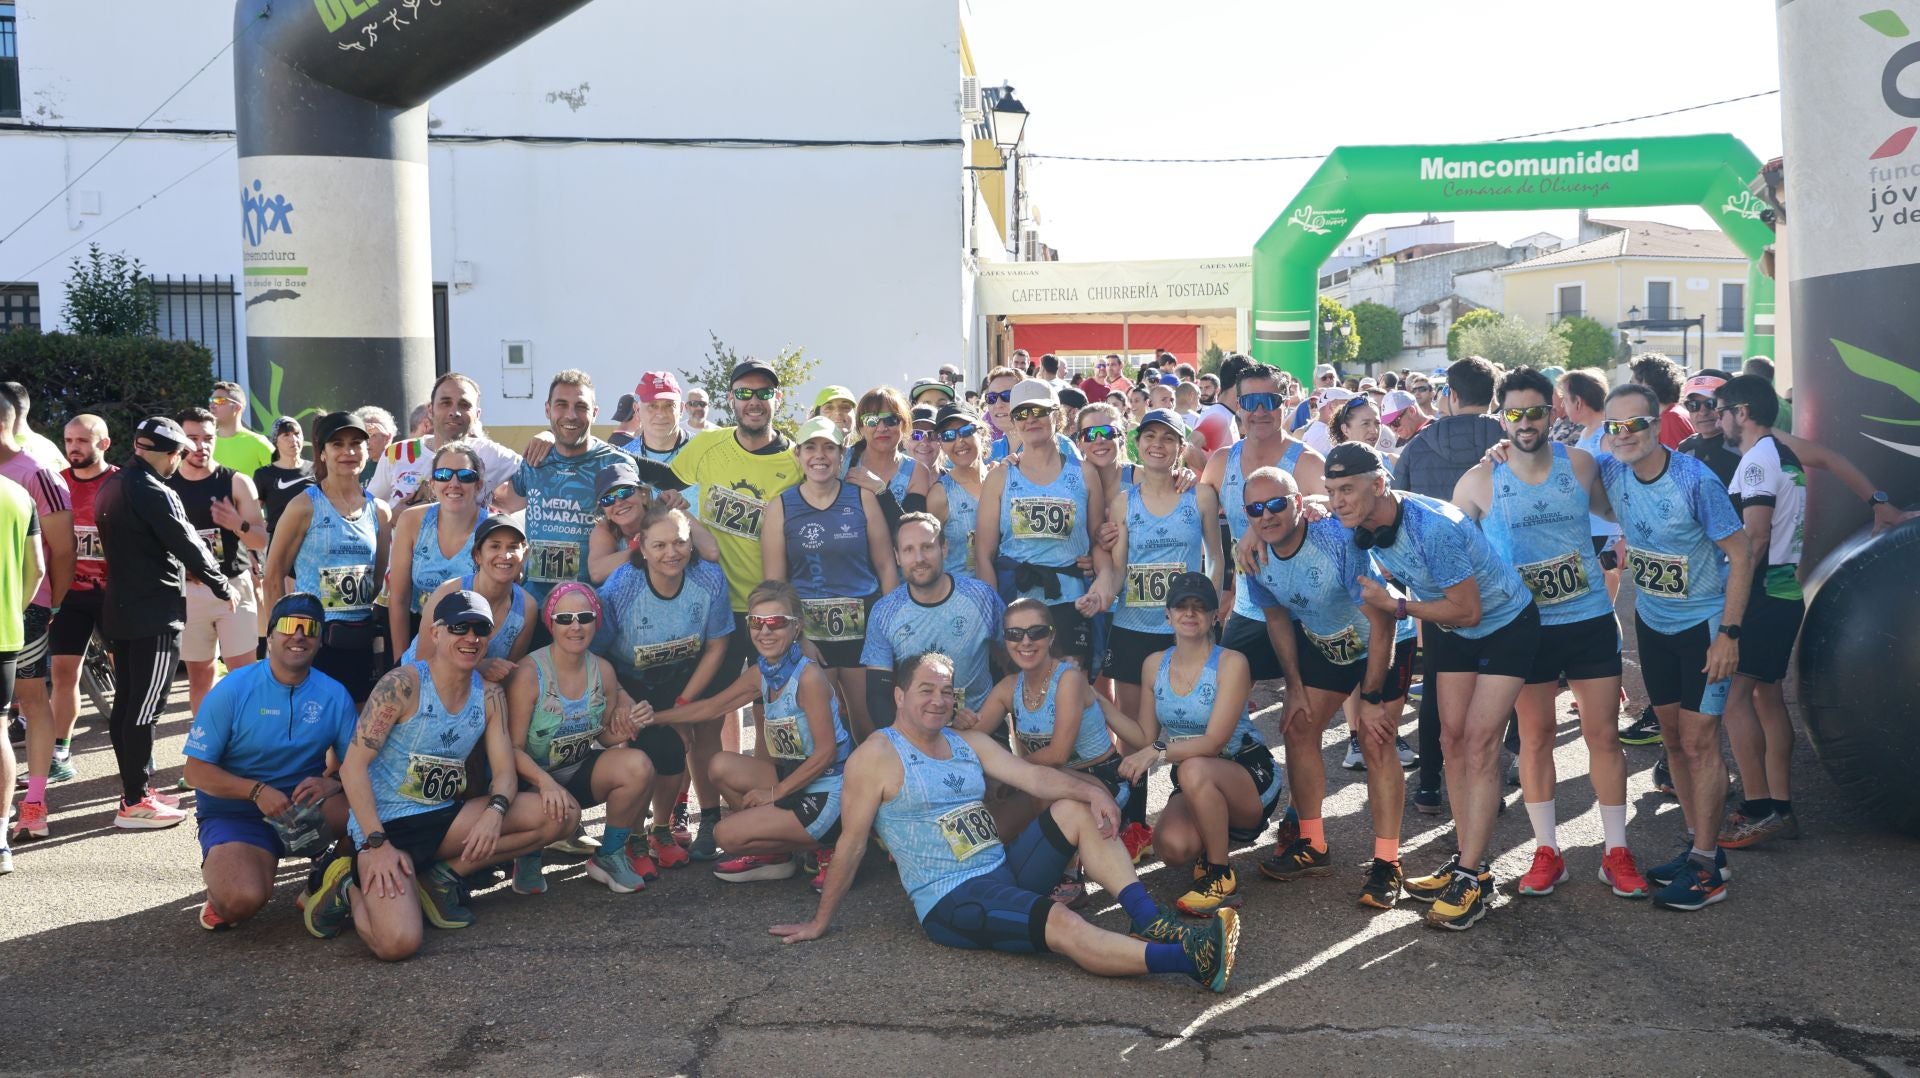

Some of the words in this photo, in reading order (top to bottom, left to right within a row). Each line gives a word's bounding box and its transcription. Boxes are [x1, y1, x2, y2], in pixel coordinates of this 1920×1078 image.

[1420, 149, 1640, 181] Mancomunidad
[1443, 181, 1514, 198] Comarca
[1517, 178, 1535, 195] de
[1540, 176, 1612, 198] Olivenza
[1872, 214, 1885, 233] y
[285, 278, 307, 287] Base
[1012, 287, 1079, 302] CAFETERIA
[1087, 282, 1159, 300] CHURRERÍA
[1166, 281, 1230, 299] TOSTADAS
[526, 505, 541, 520] 38
[541, 498, 581, 511] MEDIA
[714, 495, 762, 535] 121
[1029, 505, 1065, 534] 59
[75, 532, 93, 557] 1
[540, 548, 566, 578] 11
[1632, 556, 1685, 594] 223
[340, 574, 374, 606] 90
[1537, 562, 1578, 600] 30
[827, 607, 845, 637] 6
[422, 767, 460, 800] 66
[955, 809, 1000, 847] 188
